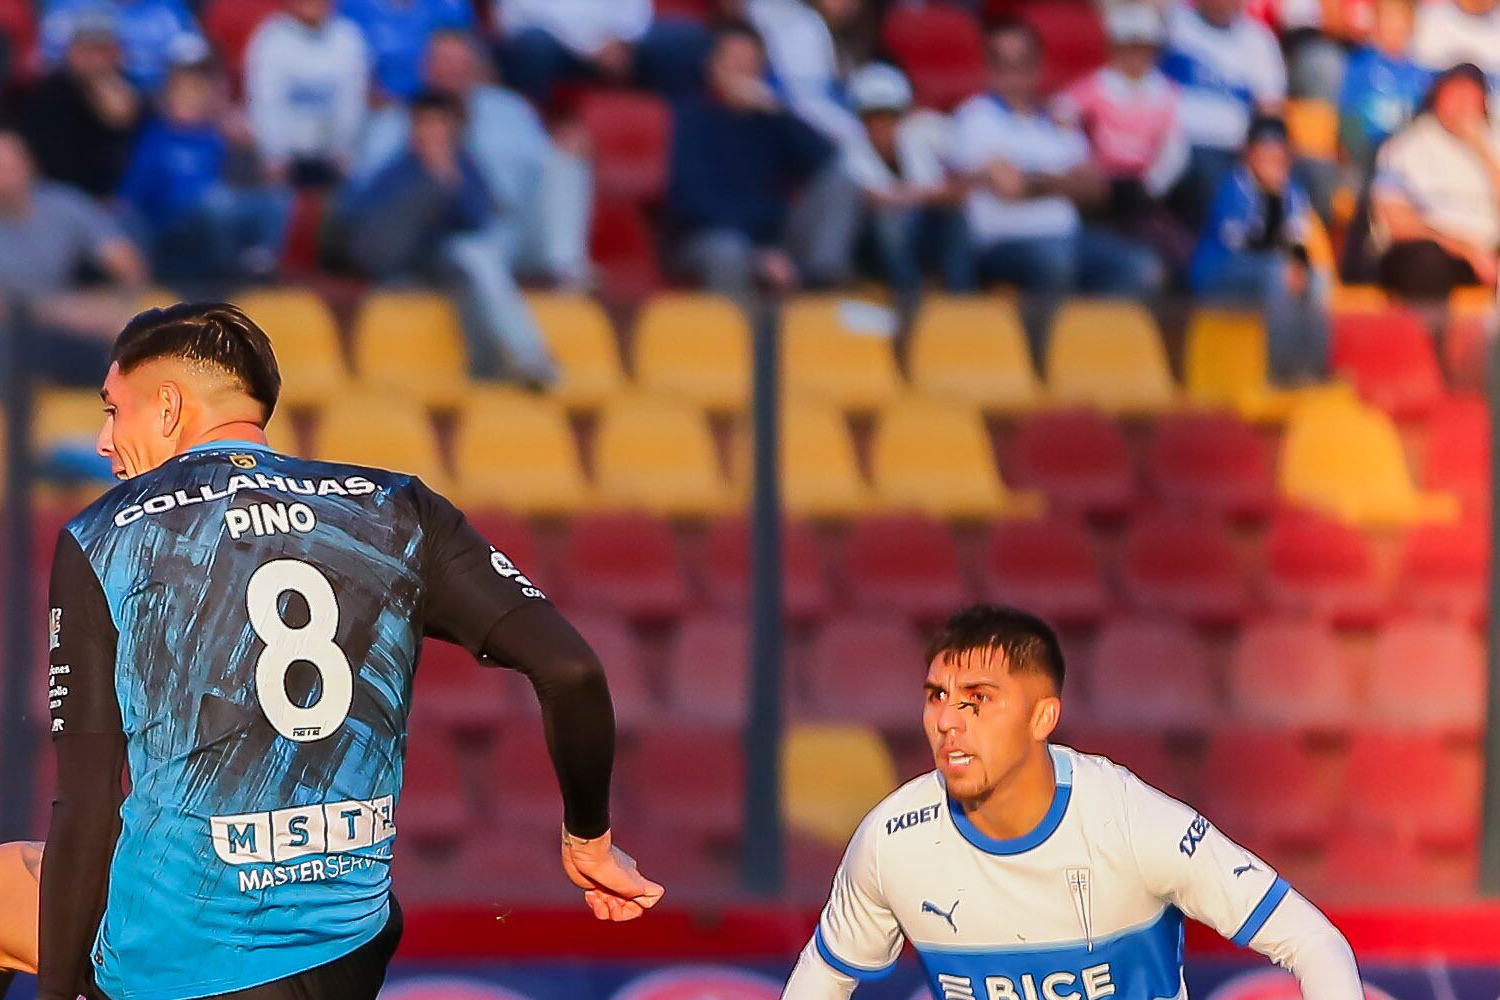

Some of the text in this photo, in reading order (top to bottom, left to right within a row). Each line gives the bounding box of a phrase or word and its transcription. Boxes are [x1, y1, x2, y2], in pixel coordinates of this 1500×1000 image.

[225, 502, 317, 540] PINO
[245, 557, 354, 742] 8
[885, 802, 942, 835] 1XBET
